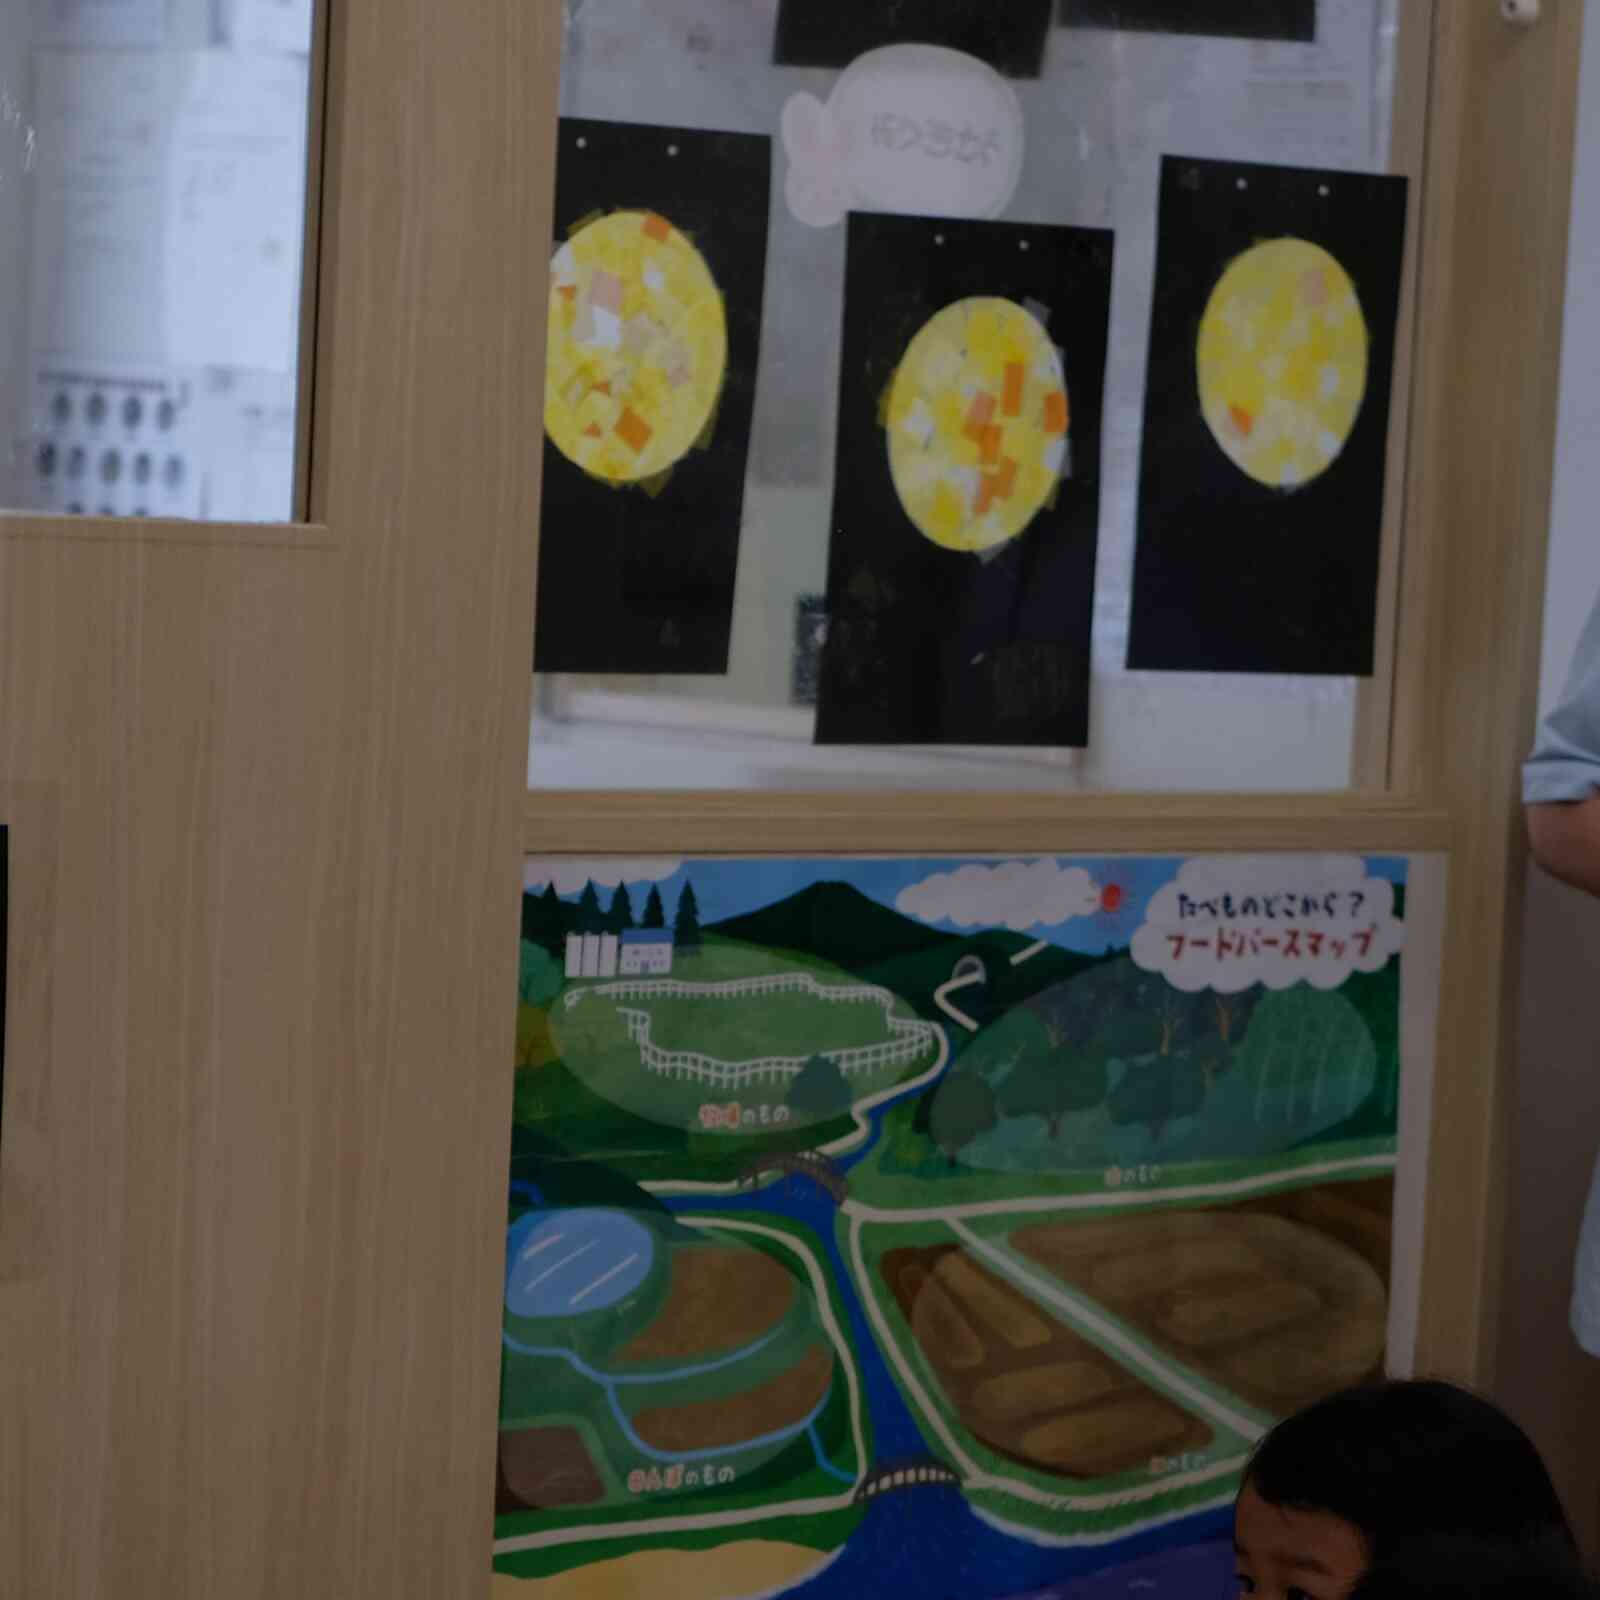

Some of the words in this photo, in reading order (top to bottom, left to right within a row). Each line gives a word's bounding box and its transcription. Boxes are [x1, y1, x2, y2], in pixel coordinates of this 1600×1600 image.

[1166, 922, 1378, 961] フードバースマップ
